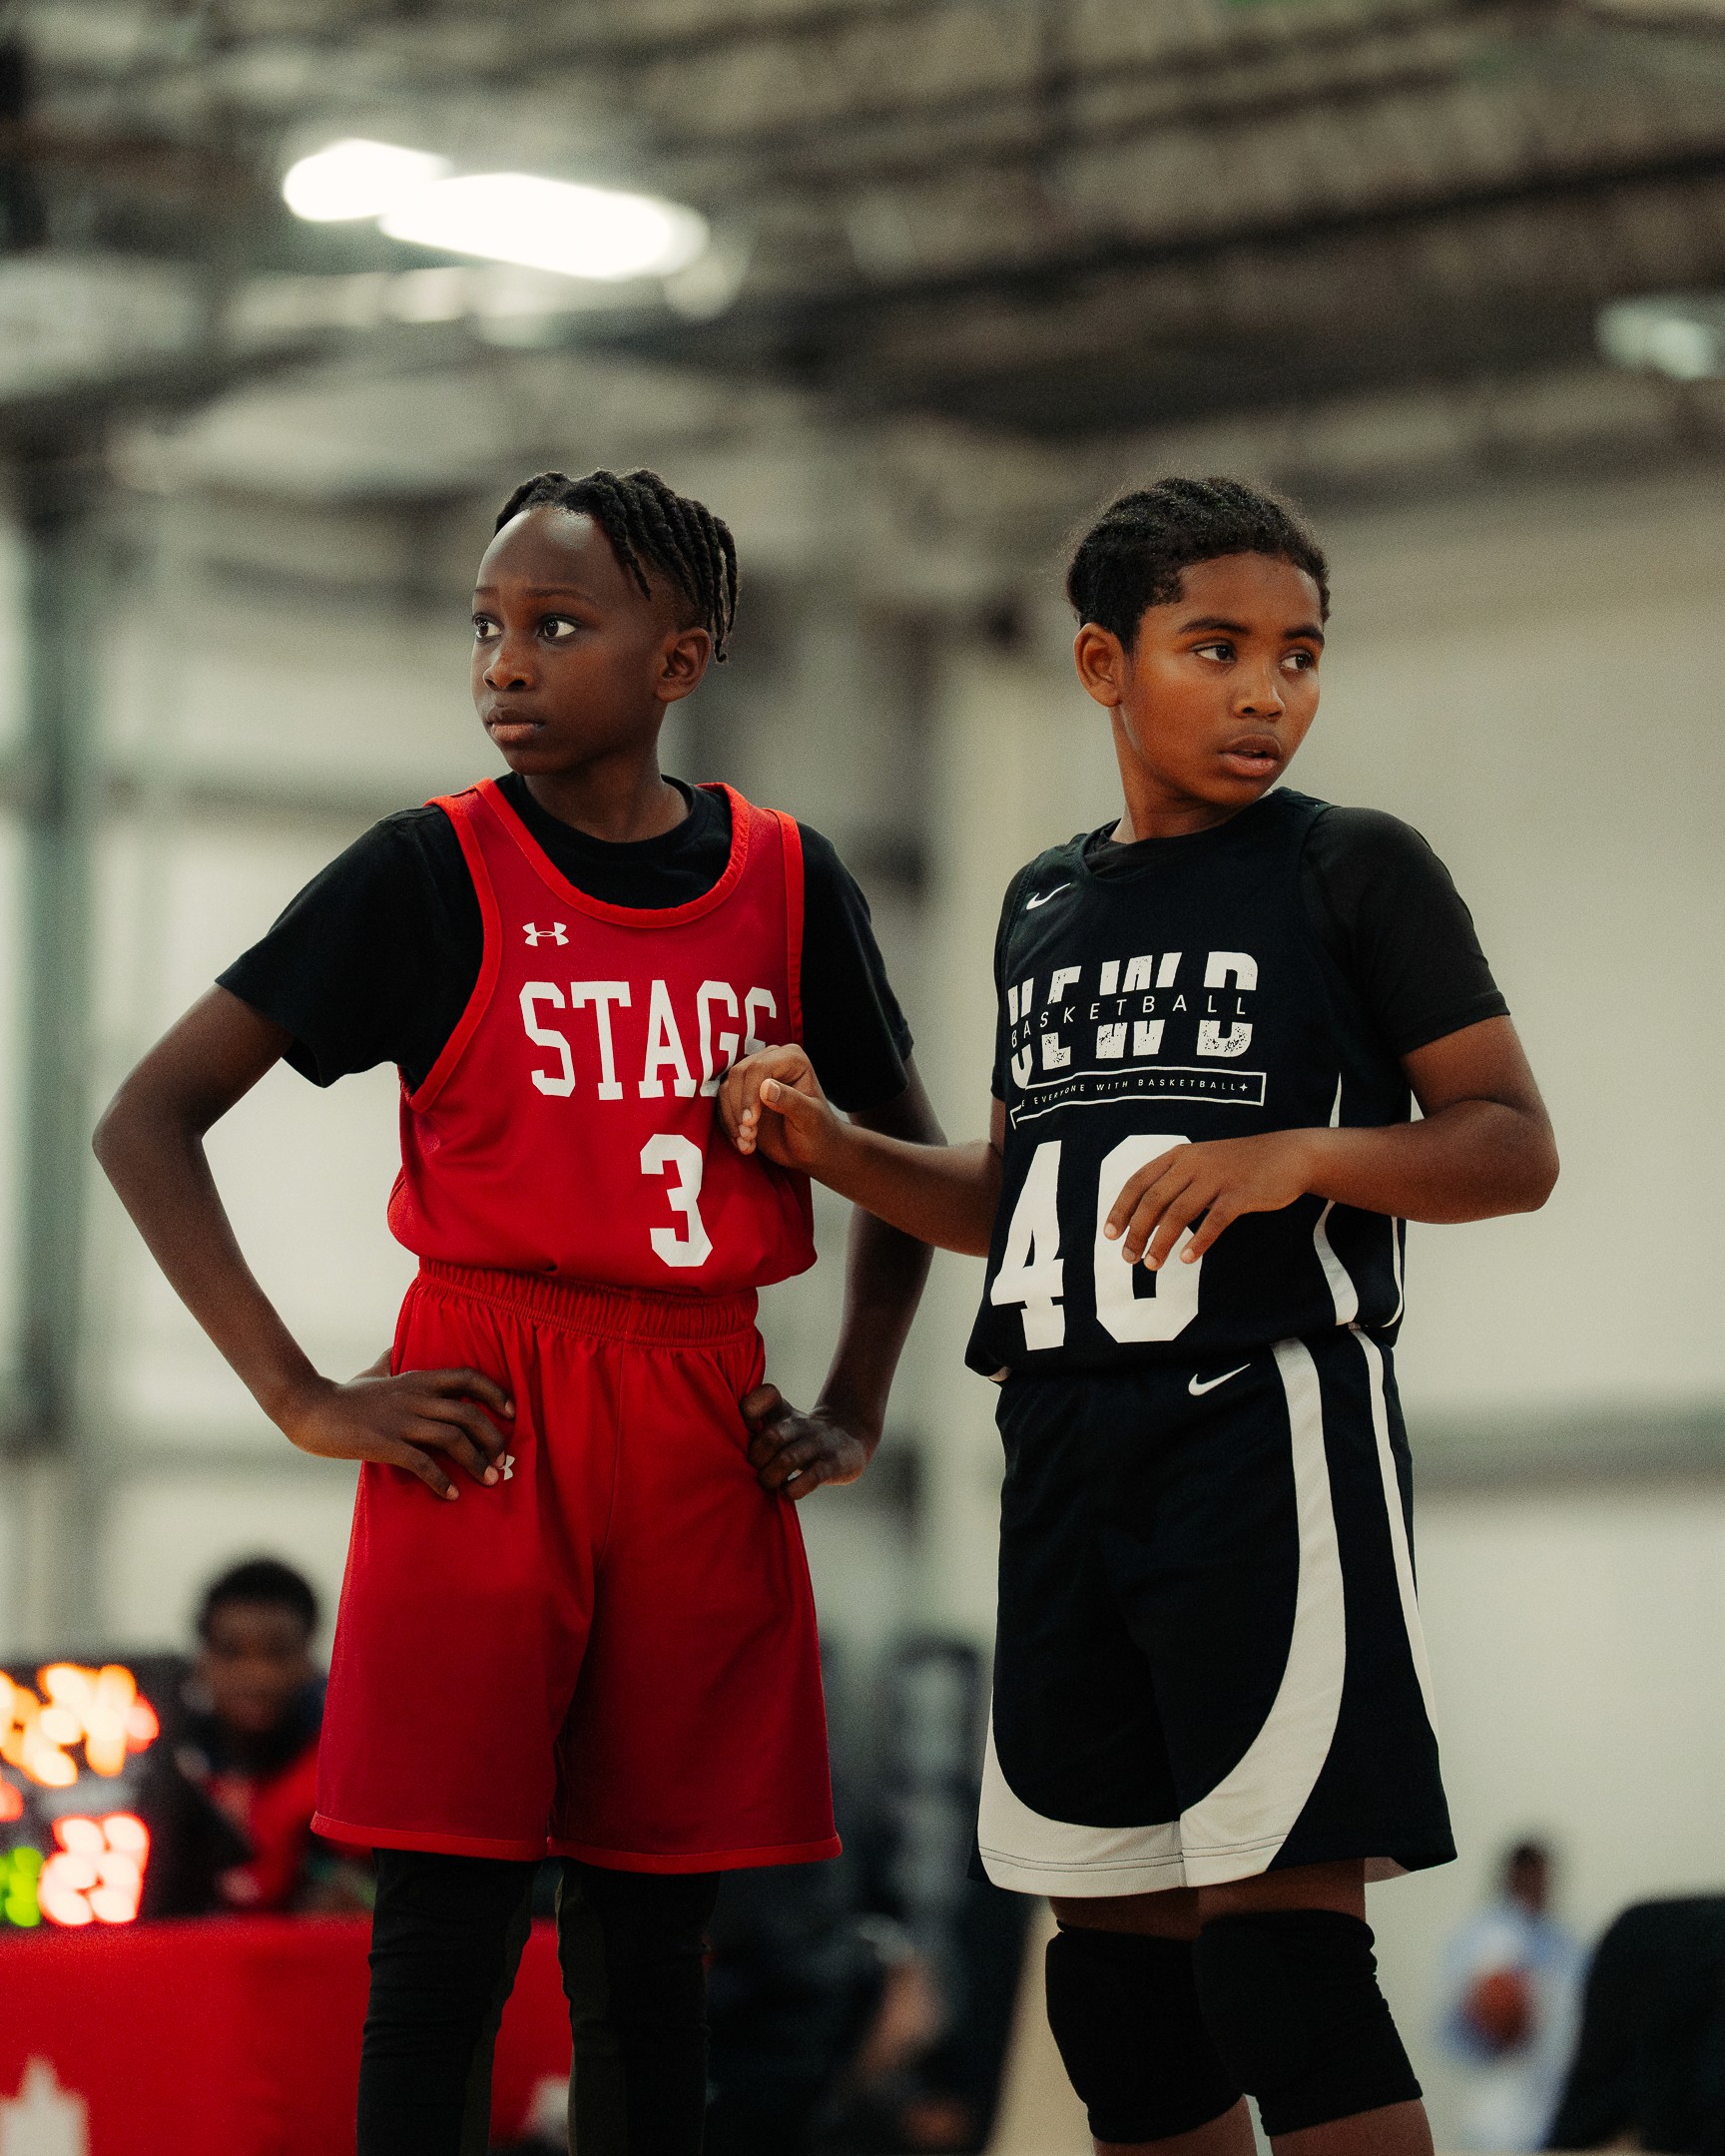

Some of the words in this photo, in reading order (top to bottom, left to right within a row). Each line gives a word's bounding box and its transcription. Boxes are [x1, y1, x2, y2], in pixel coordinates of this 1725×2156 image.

[1010, 994, 1247, 1049] BASKETBALL
[1033, 1084, 1086, 1105] EVERYONE
[1096, 1080, 1129, 1092] WITH
[1137, 1078, 1236, 1091] BASKETBALL
[639, 1133, 714, 1268] 3
[989, 1134, 1204, 1351] 40
